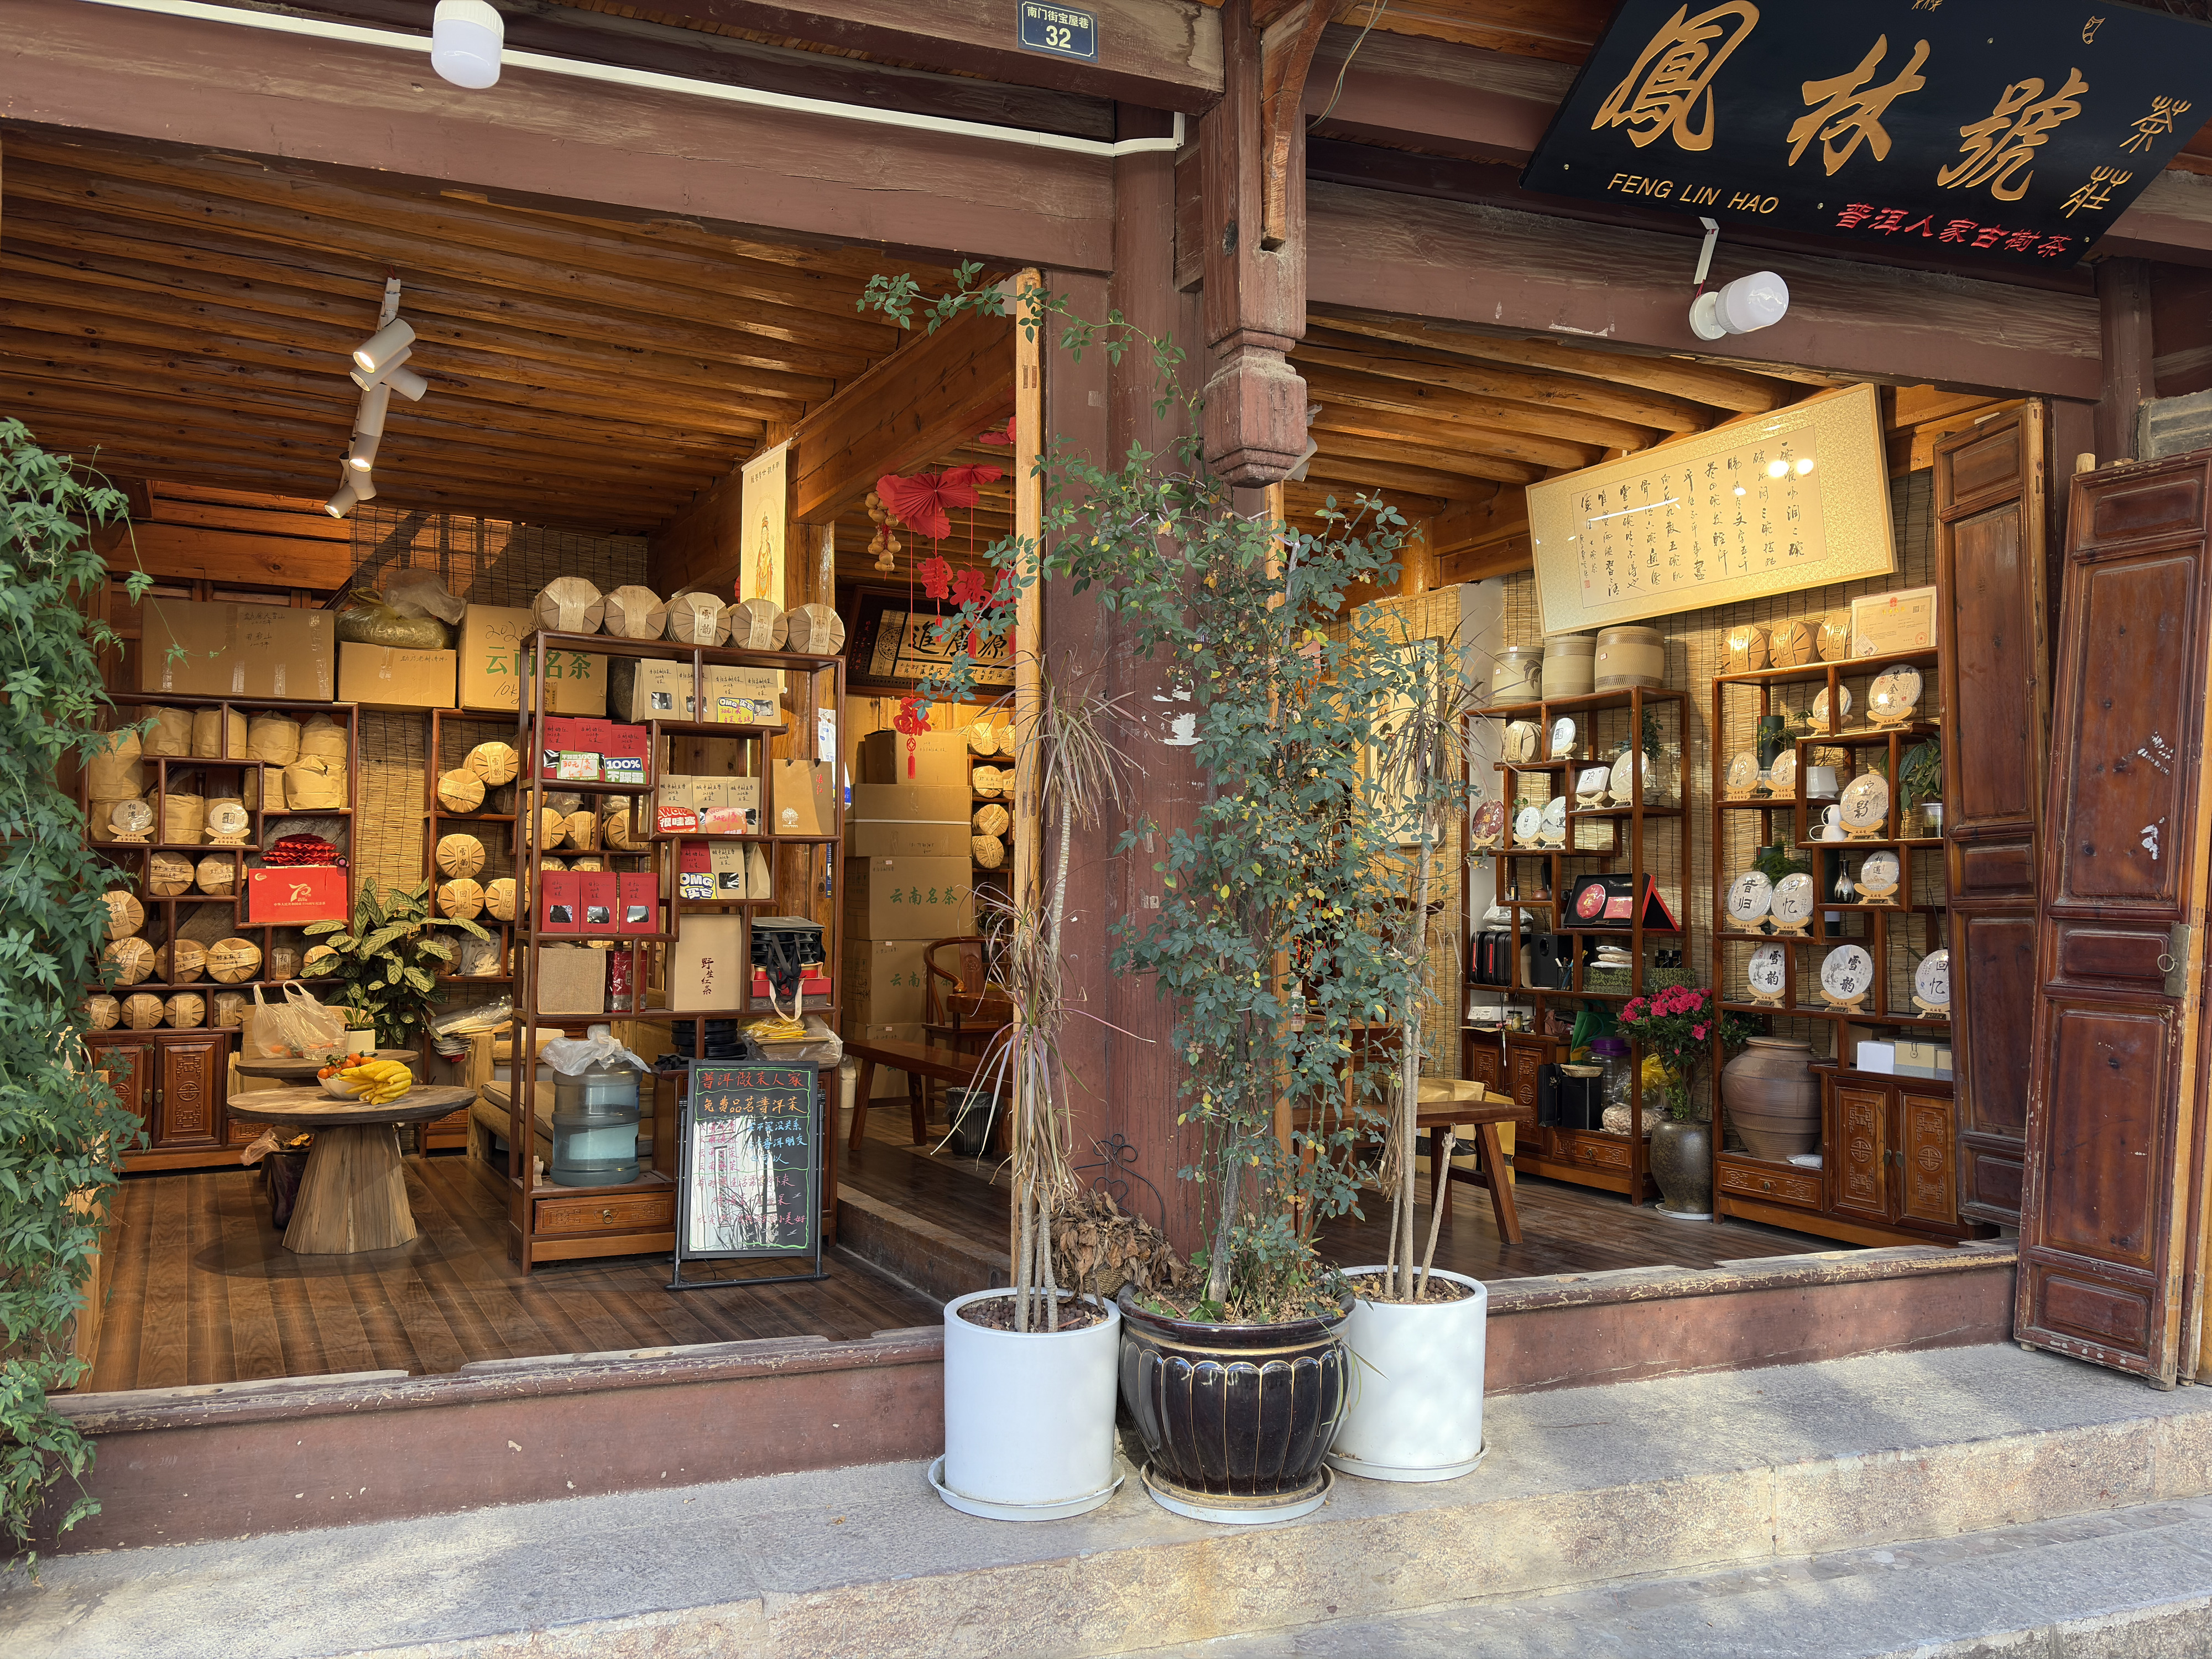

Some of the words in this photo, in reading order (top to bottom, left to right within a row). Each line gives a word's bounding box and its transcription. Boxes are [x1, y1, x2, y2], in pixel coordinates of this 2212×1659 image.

[1027, 6, 1089, 29] 南门街宝屋巷
[1046, 25, 1071, 49] 32
[1592, 0, 2089, 201] 鳳林號
[1607, 173, 1673, 199] FENG
[1679, 184, 1721, 205] LIN
[1727, 191, 1779, 213] HAO
[1831, 625, 1843, 649] 回忆
[719, 698, 738, 708] OMG
[607, 760, 640, 769] 100%
[607, 771, 644, 784] 不踩雷
[658, 816, 696, 827] 很哇塞
[680, 873, 714, 887] OMG
[459, 890, 468, 909] 回忆
[503, 890, 513, 908] 回忆
[890, 886, 957, 905] 云南名茶
[701, 958, 713, 995] 野生红茶
[890, 972, 951, 988] 云南茶
[1930, 961, 1948, 994] 回忆
[700, 1071, 804, 1089] 普洱做茶人家
[704, 1095, 807, 1114] 免费品茗普洱茶
